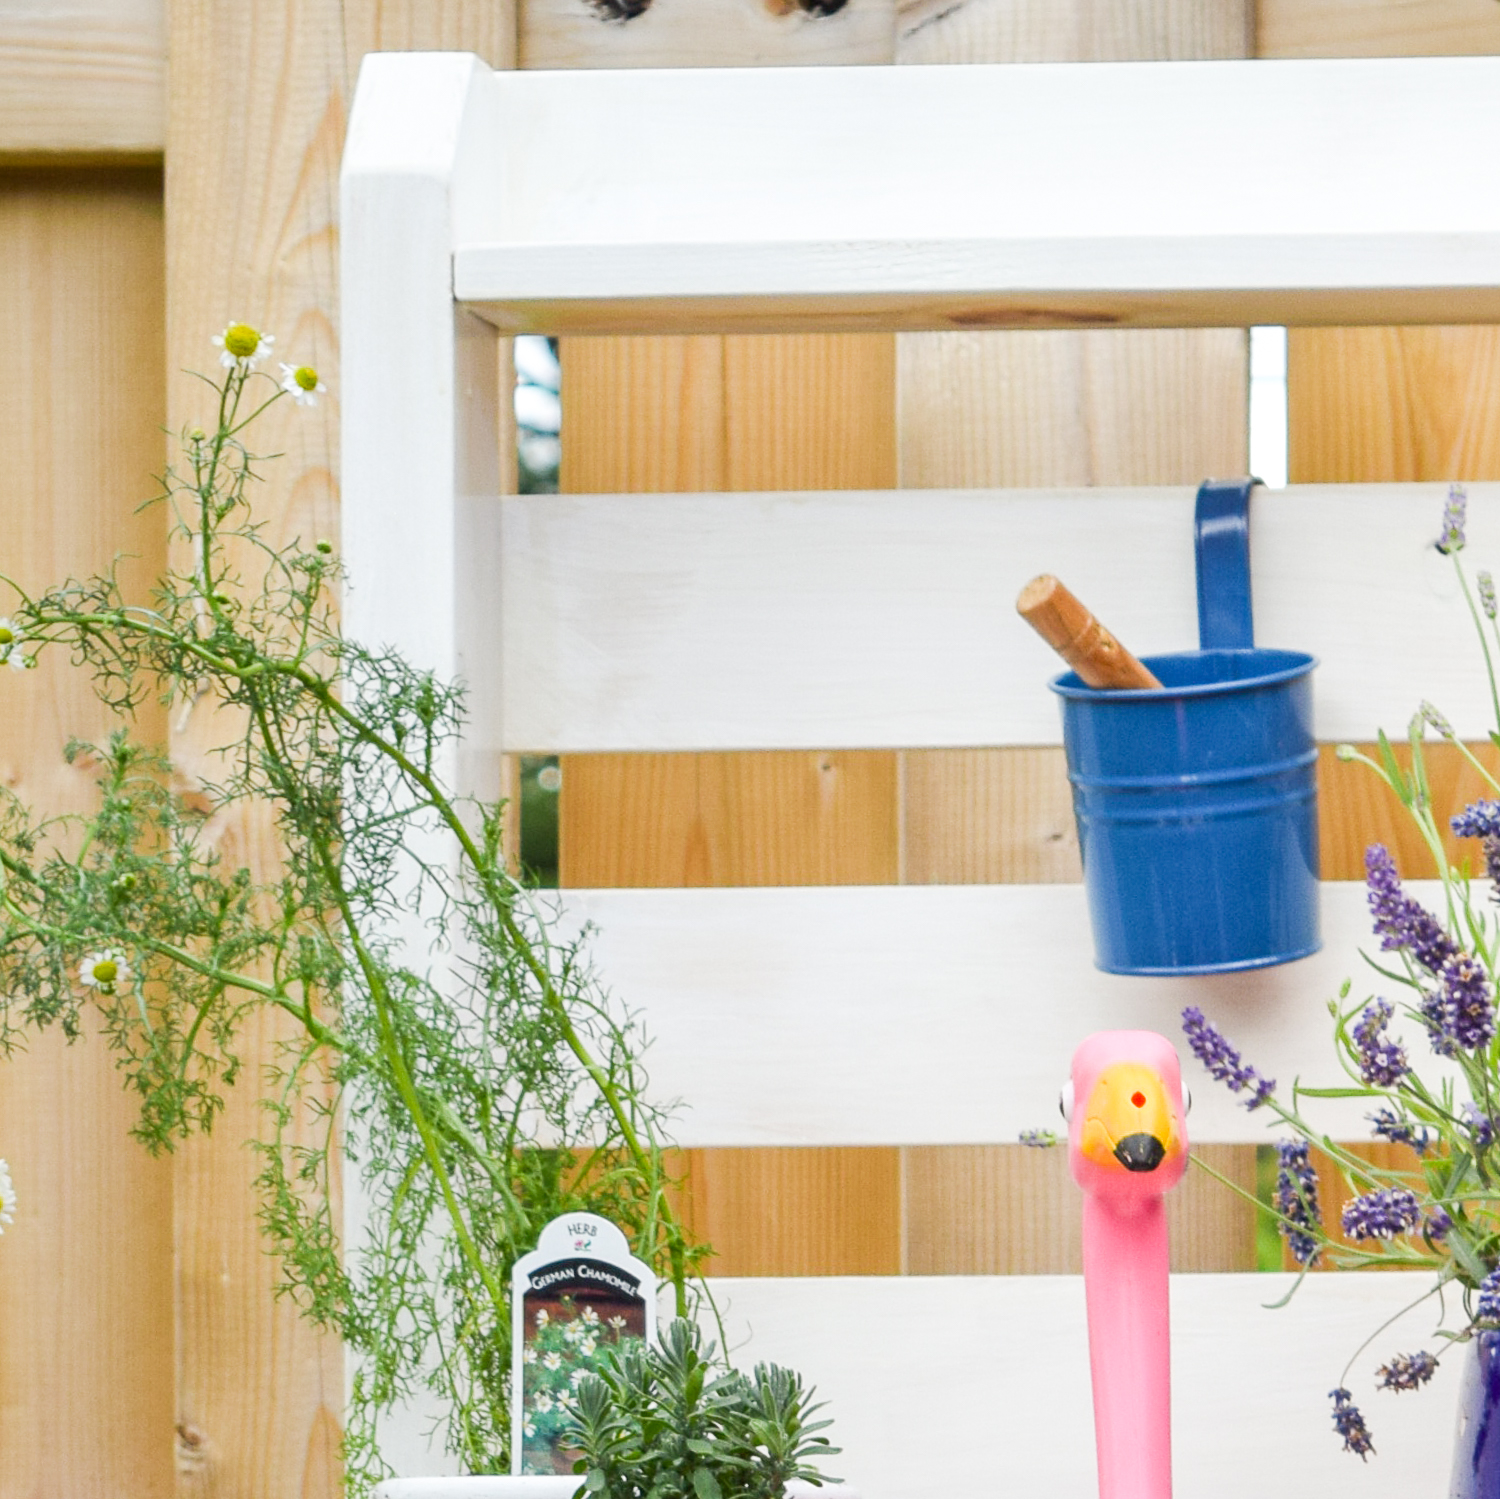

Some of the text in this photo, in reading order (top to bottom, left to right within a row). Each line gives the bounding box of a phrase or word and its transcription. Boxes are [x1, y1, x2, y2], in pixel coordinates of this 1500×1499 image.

[567, 1222, 598, 1237] HERB
[531, 1264, 638, 1297] GERMAN CHAMOMILE
